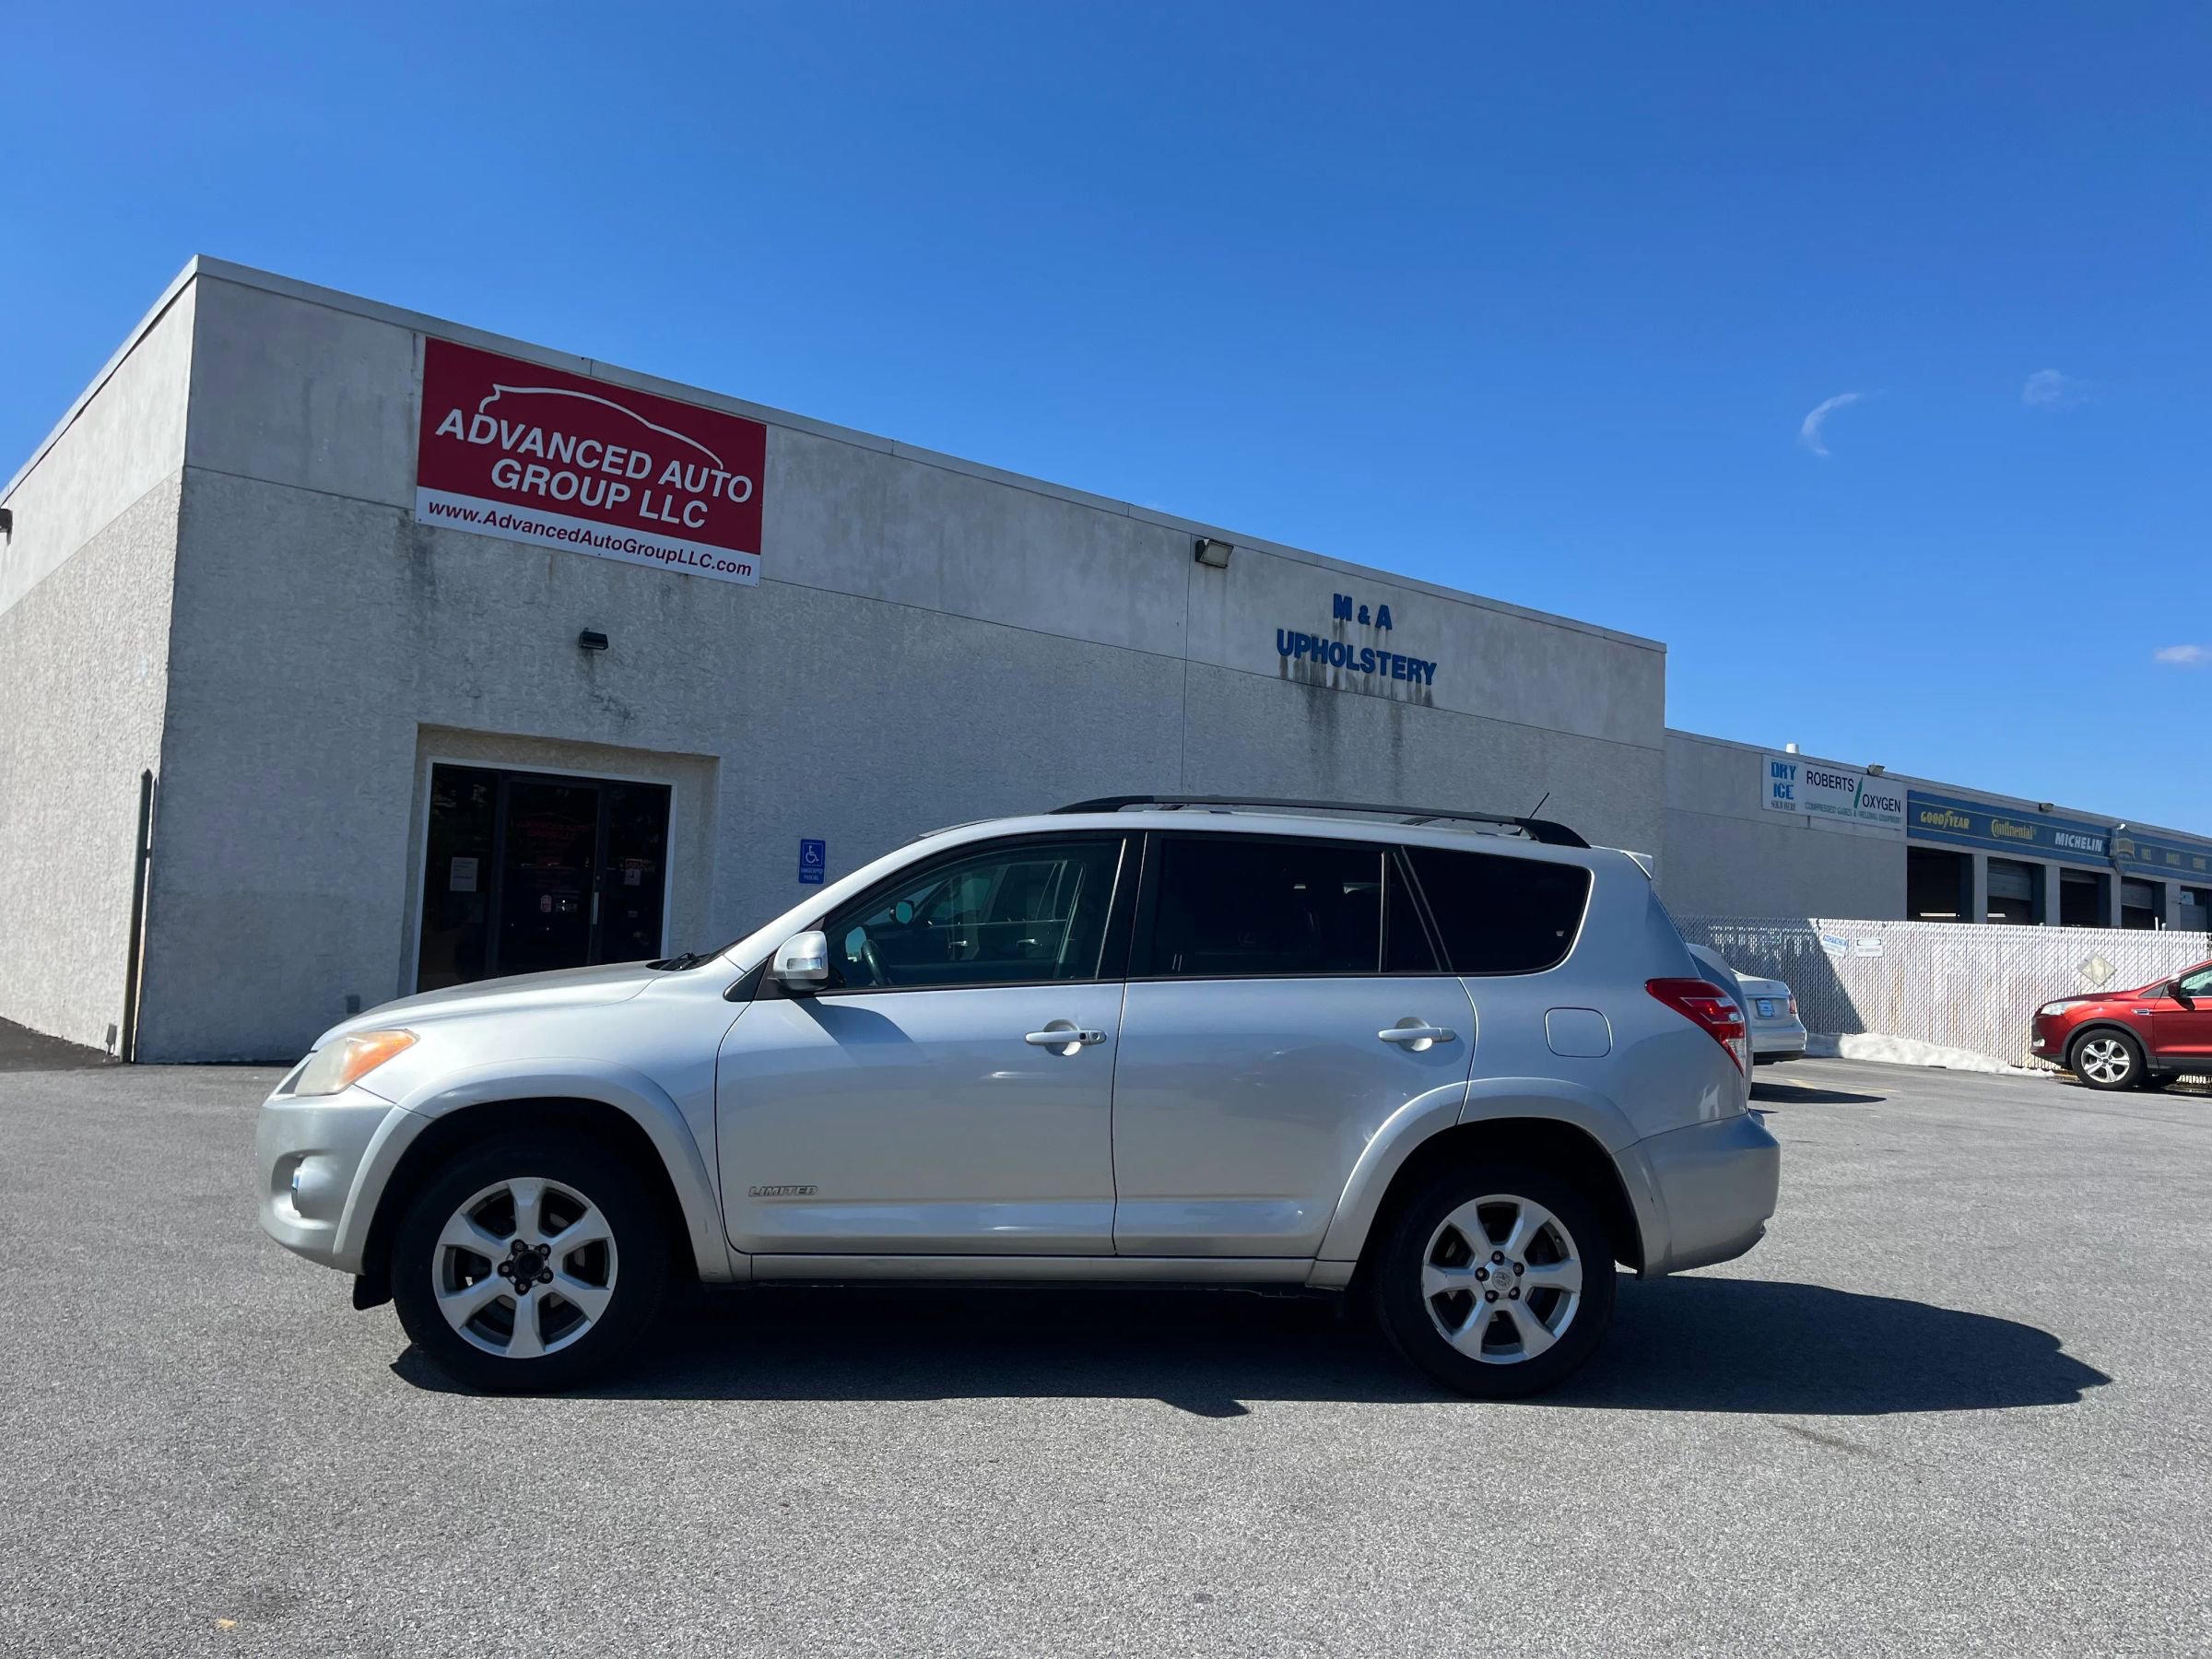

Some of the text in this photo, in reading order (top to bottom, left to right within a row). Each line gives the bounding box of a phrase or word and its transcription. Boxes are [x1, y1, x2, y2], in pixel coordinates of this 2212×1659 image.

[436, 408, 753, 503] ADVANCED AUTO
[491, 458, 708, 528] GROUP LLC
[429, 500, 751, 577] www.AdvancedAutoGroupLLC.com
[1333, 594, 1393, 630] M & A
[1277, 629, 1437, 686] UPHOLSTERY
[1771, 761, 1796, 781] DRY
[1806, 771, 1854, 793] ROBERTS
[1773, 782, 1794, 800] ICE
[1862, 794, 1901, 814] OXYGEN
[1920, 810, 1970, 830] GOODYEAR
[1991, 818, 2034, 841] Continental
[2054, 832, 2103, 853] MICHELIN
[748, 1185, 818, 1197] LIMITED
